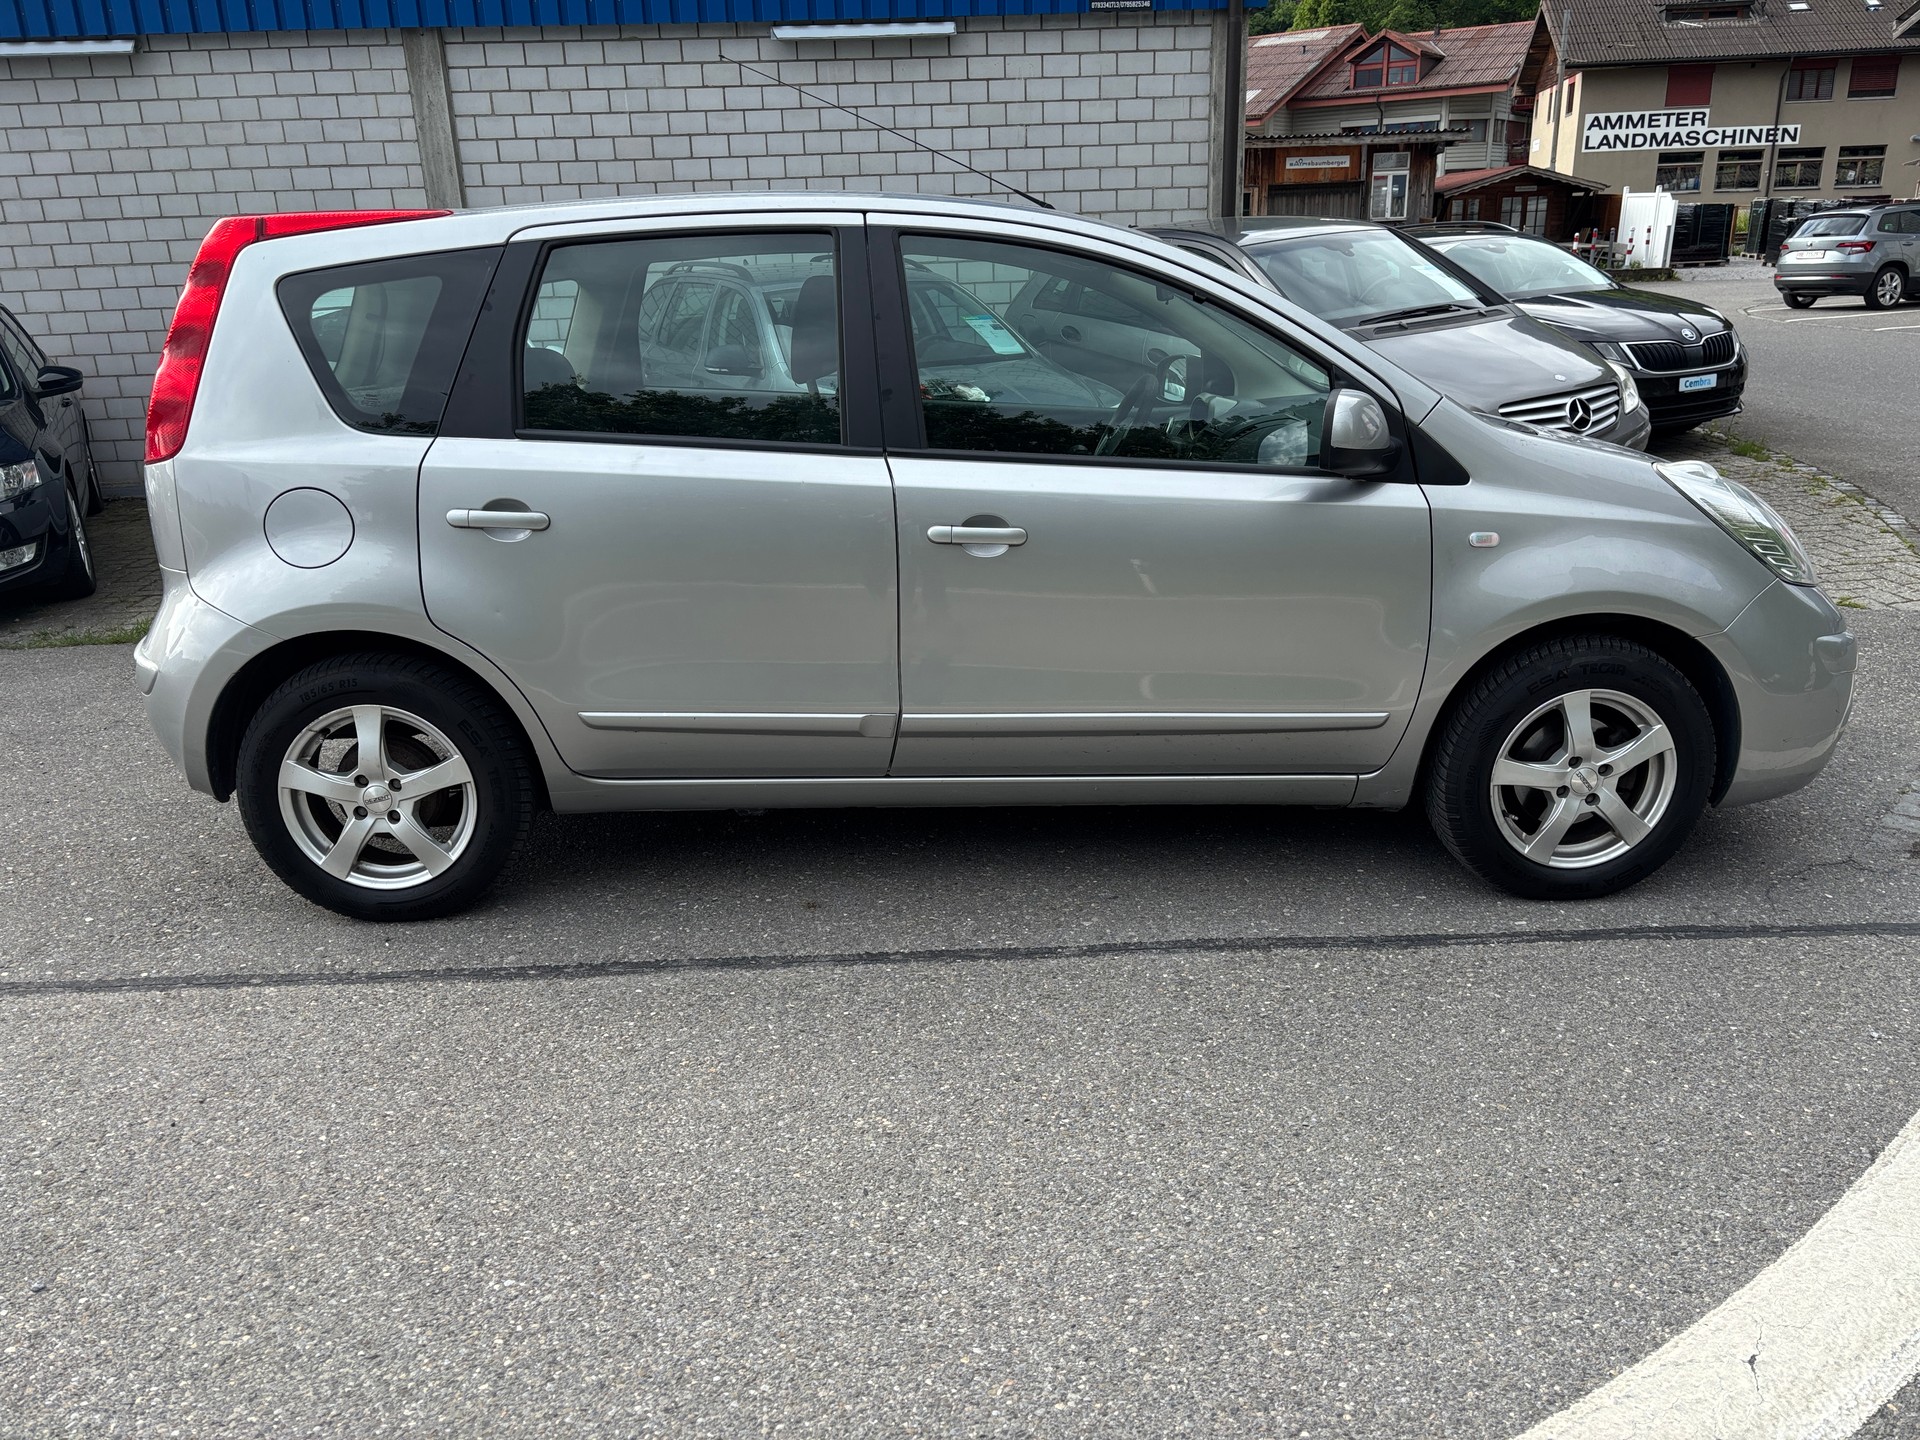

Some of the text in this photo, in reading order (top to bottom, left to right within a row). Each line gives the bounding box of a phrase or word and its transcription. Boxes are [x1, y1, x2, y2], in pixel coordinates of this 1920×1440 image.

[1587, 111, 1707, 131] AMMETER
[1584, 127, 1799, 150] LANDMASCHINEN
[1684, 377, 1712, 388] Cembra
[339, 677, 359, 690] R15
